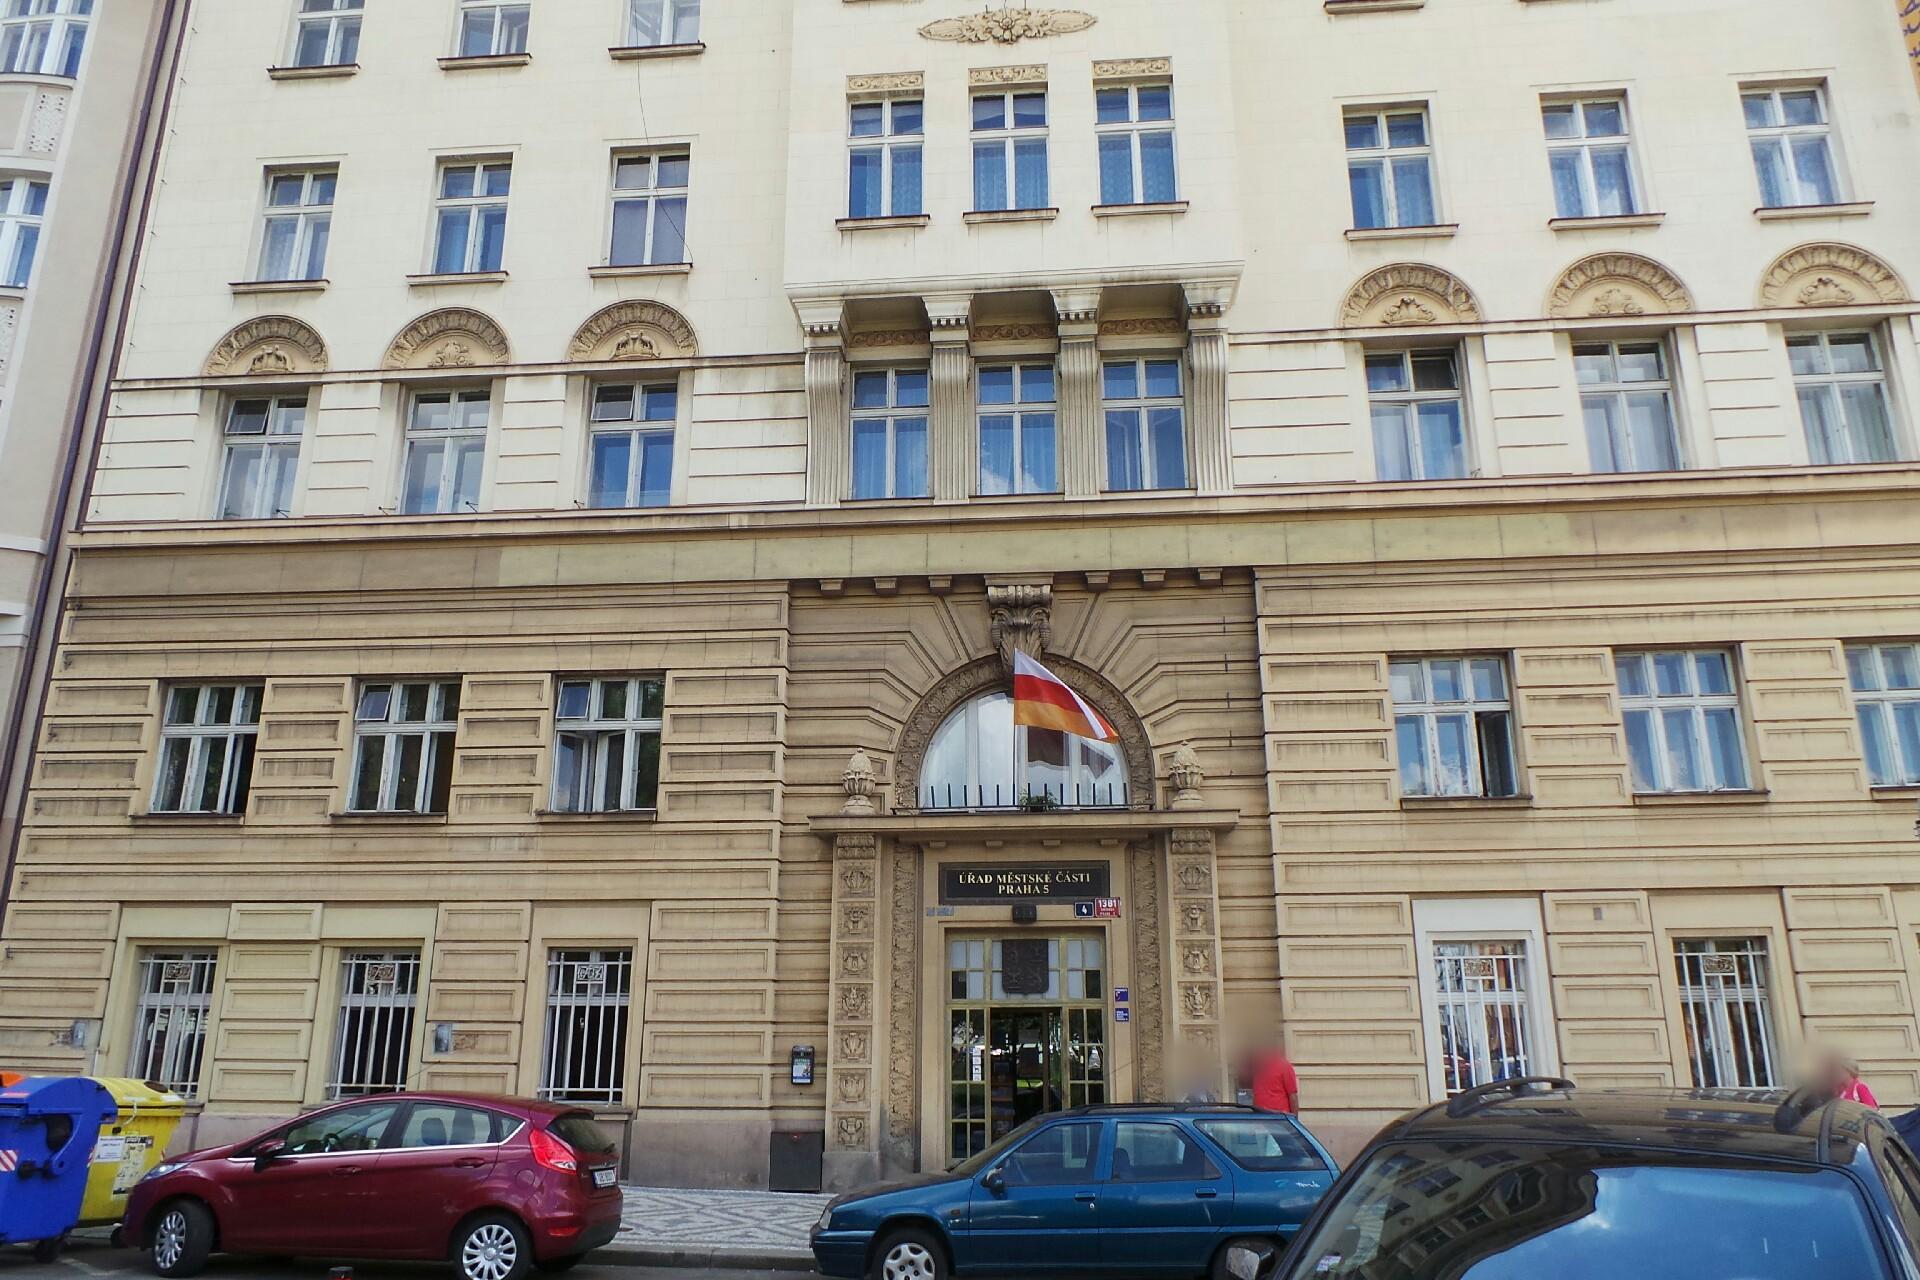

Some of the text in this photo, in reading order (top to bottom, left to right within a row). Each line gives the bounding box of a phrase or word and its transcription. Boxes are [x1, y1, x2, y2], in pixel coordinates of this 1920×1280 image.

[959, 871, 1090, 884] ÚŘAD MĚSTSKÉ ČÁSTI
[998, 884, 1050, 895] PRAHA 5
[1097, 899, 1117, 908] 1381
[1081, 904, 1088, 915] 4
